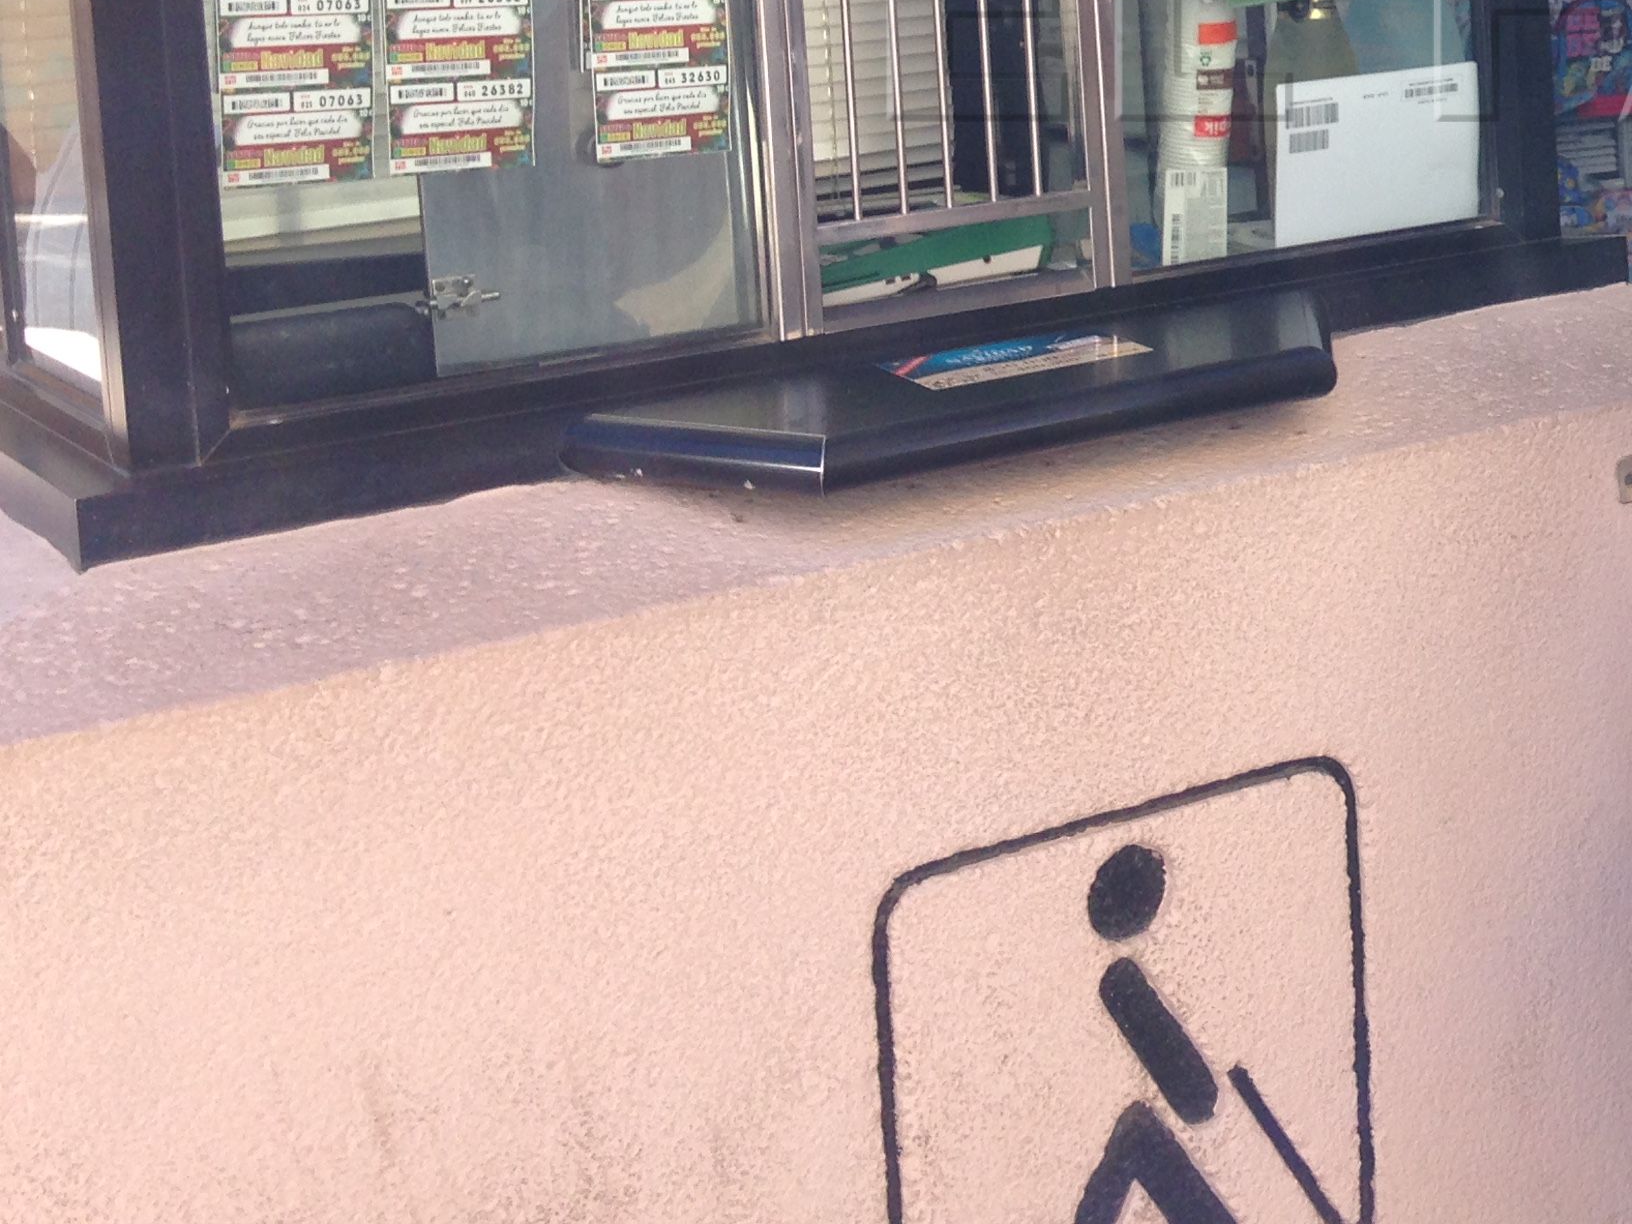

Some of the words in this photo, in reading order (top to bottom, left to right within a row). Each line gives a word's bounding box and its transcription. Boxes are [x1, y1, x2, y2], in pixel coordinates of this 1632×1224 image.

[316, 0, 362, 11] 07063
[681, 70, 720, 83] 32630
[481, 84, 524, 96] 26382
[319, 94, 364, 107] 07063
